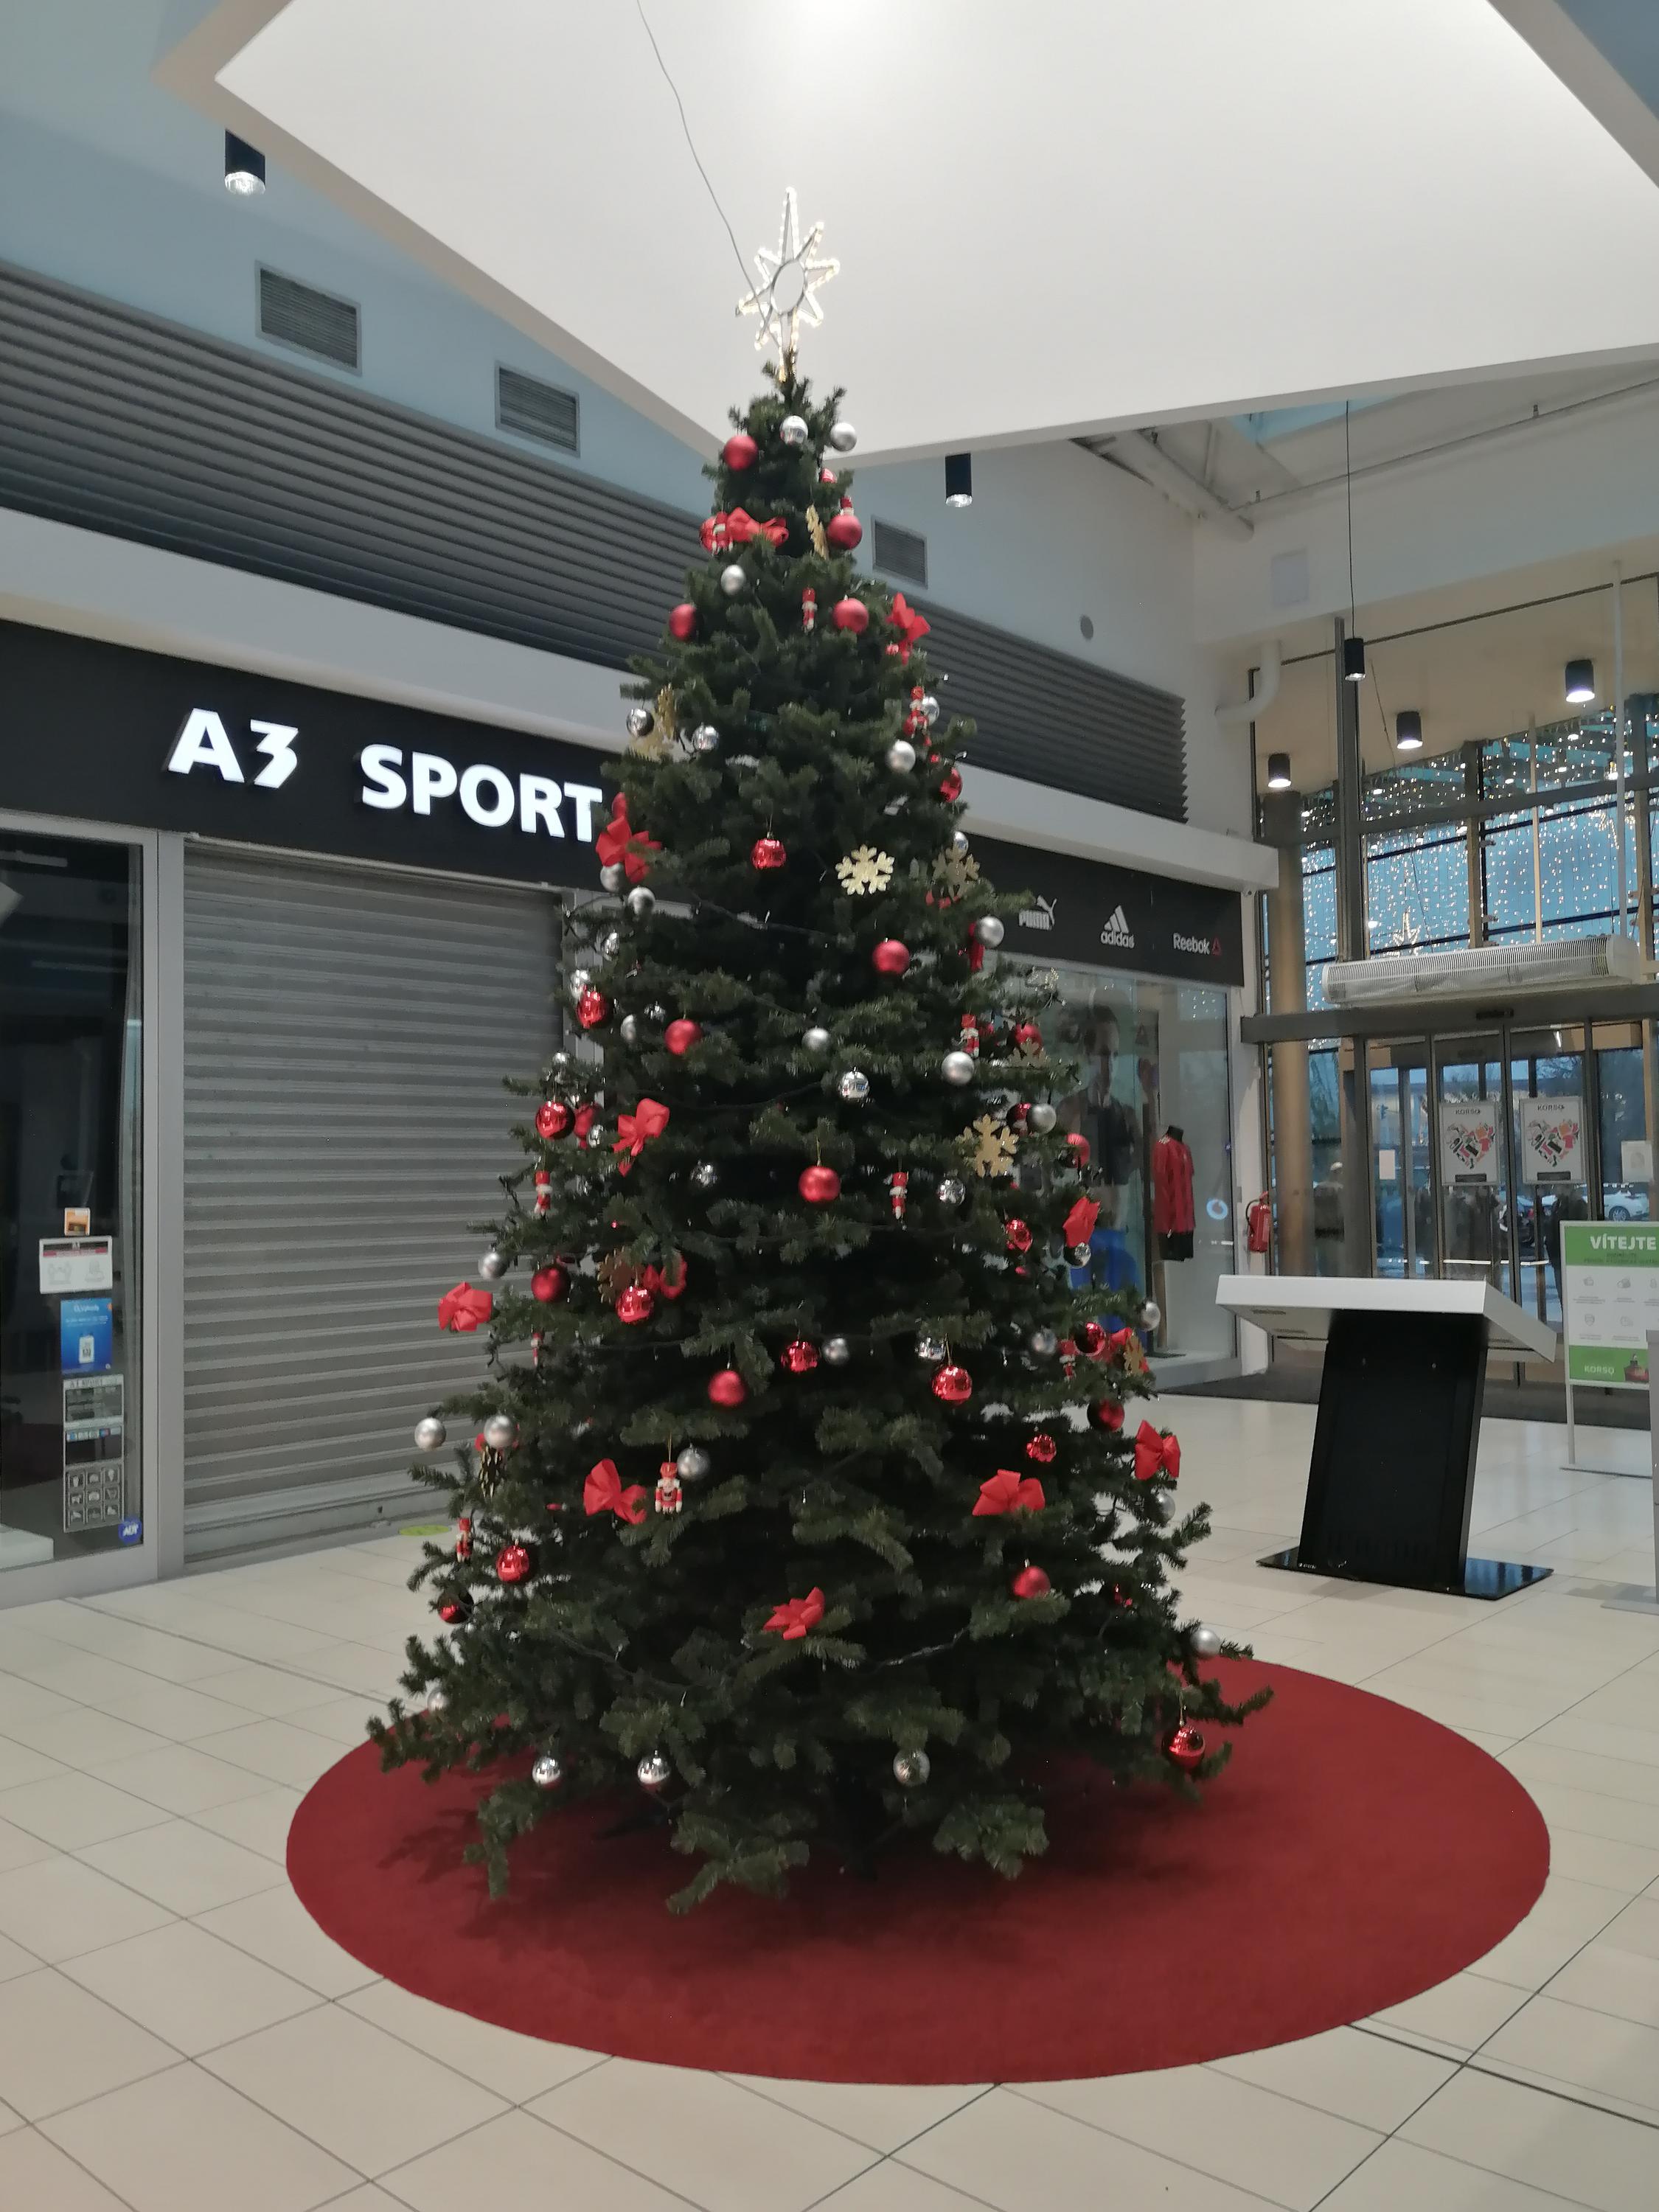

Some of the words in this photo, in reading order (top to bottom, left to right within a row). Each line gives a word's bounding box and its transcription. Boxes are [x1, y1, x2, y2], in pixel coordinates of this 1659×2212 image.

[167, 707, 299, 789] A3
[360, 743, 602, 842] SPORT
[1101, 931, 1135, 949] adidas
[1173, 932, 1210, 954] Reebok
[1590, 1233, 1657, 1251] VÍTEJTE
